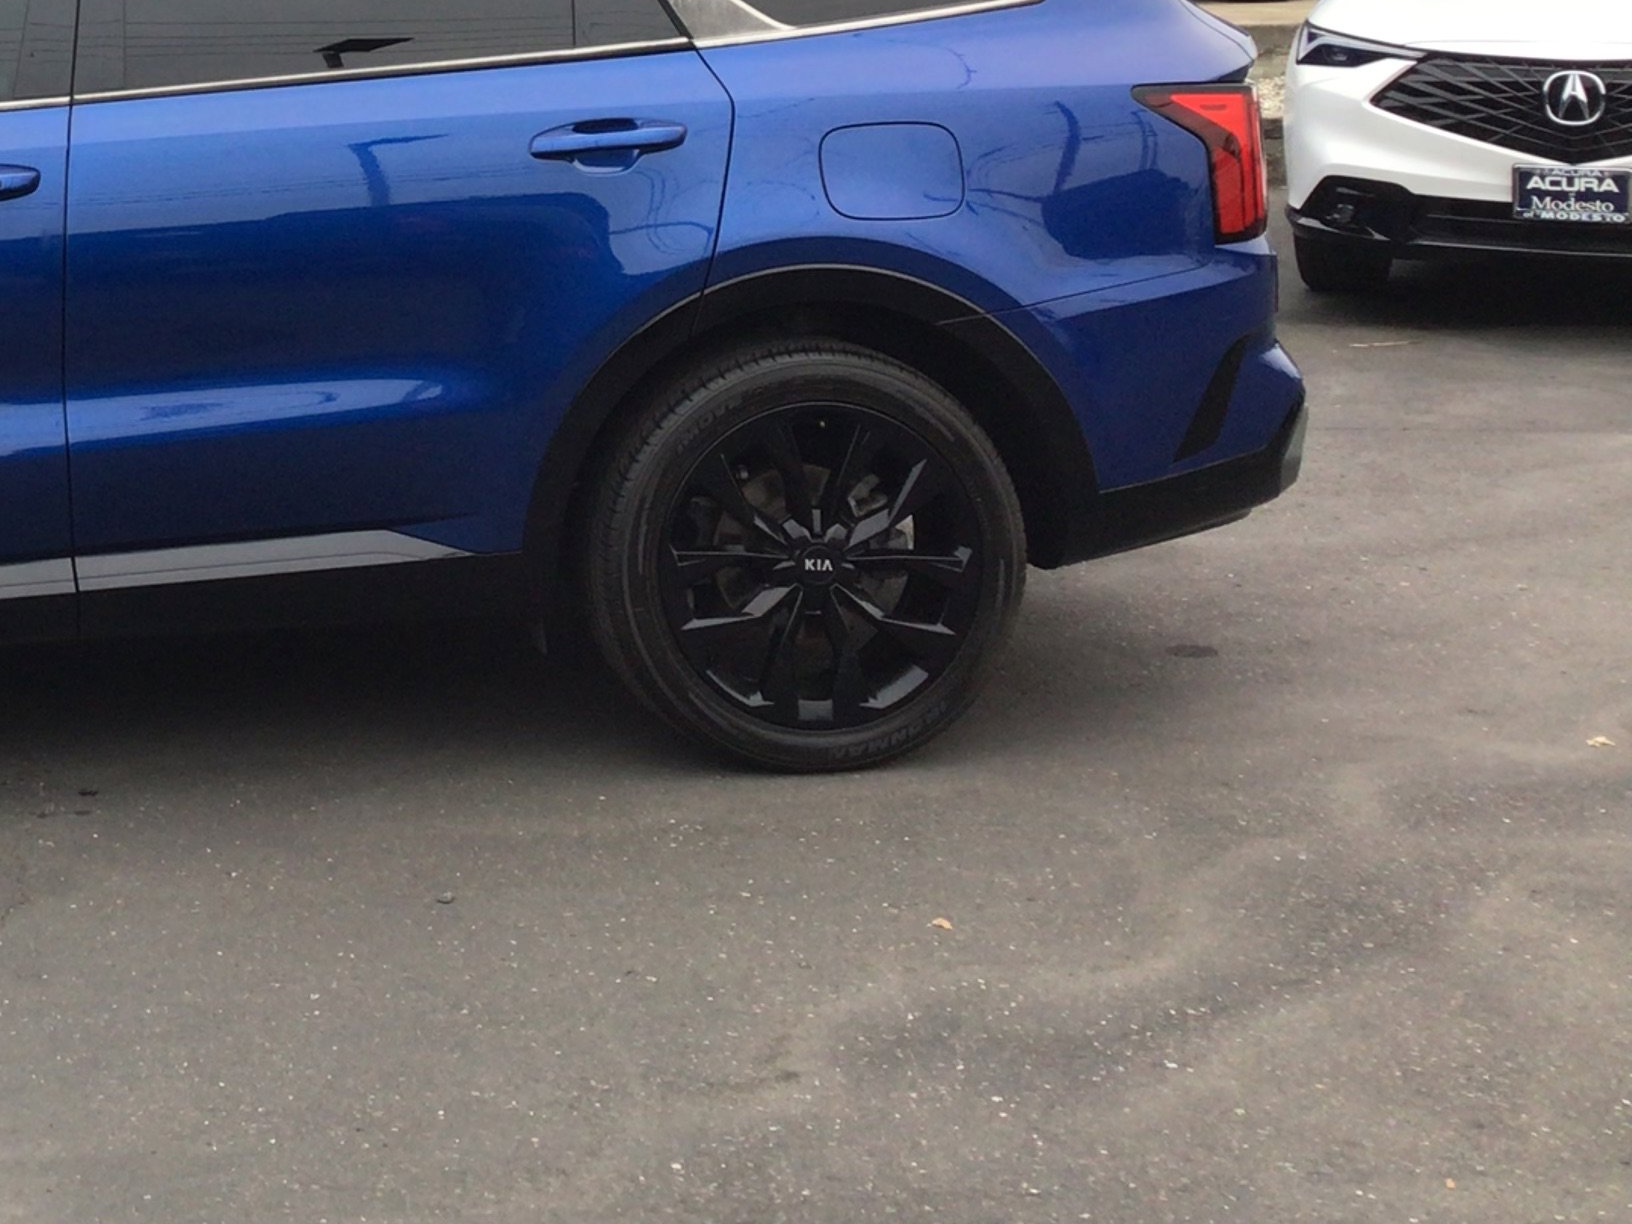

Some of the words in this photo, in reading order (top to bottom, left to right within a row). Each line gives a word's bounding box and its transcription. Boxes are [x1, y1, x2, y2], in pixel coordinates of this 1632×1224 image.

[1526, 176, 1619, 192] ACURA
[1531, 195, 1615, 212] Modesto
[804, 558, 833, 571] KIA
